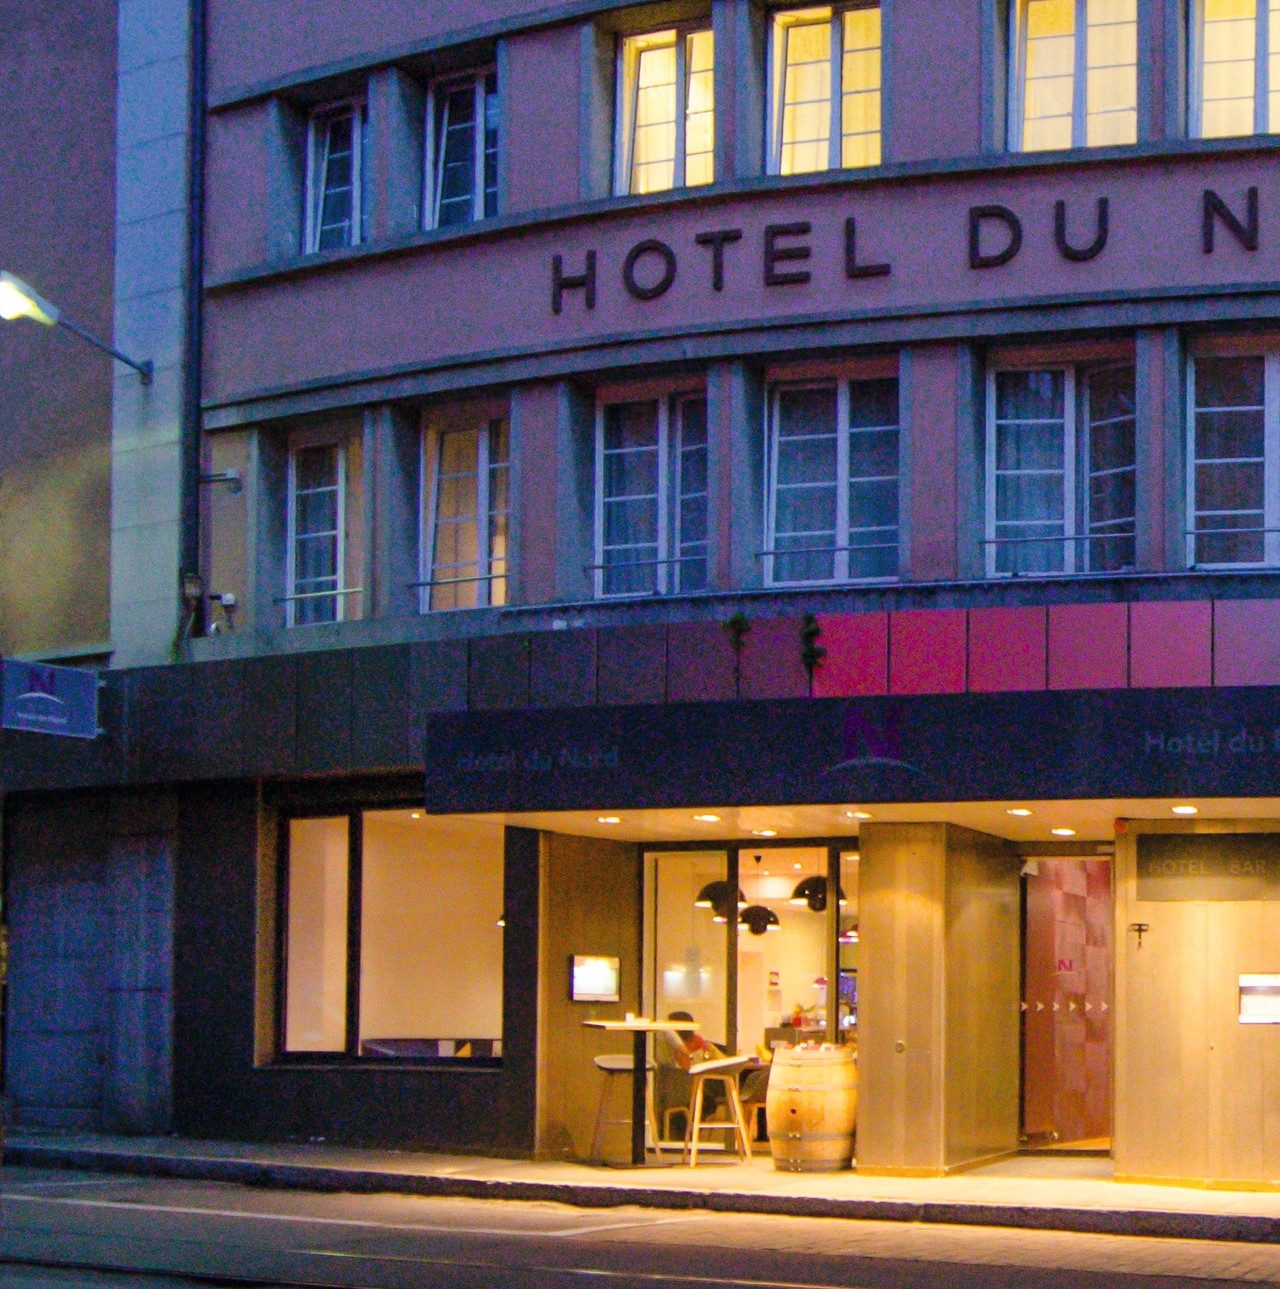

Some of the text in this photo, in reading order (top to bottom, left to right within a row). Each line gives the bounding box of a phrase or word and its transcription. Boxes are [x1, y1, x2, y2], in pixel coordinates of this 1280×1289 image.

[551, 216, 892, 315] HOTEL
[967, 197, 1110, 269] DU
[1142, 728, 1220, 756] Hotel
[1229, 726, 1264, 754] du
[1229, 858, 1266, 875] BAR
